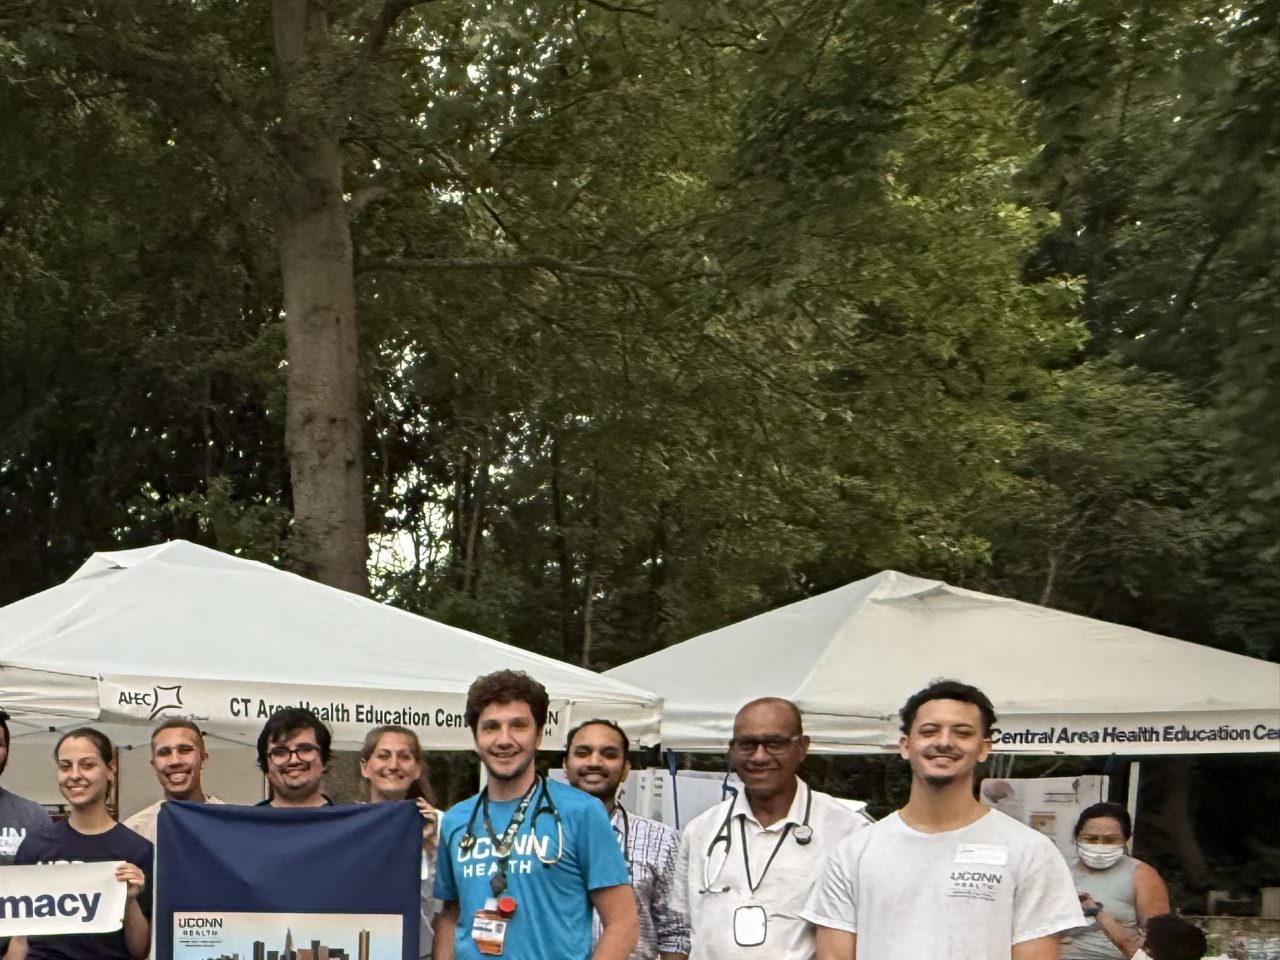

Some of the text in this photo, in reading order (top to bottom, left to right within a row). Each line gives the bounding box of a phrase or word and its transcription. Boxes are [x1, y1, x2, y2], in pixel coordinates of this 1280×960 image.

[229, 697, 251, 717] CT
[355, 704, 430, 726] Education
[991, 728, 1053, 744] Central
[1056, 727, 1098, 743] Area
[1103, 727, 1160, 743] Health
[1163, 725, 1251, 742] Education
[463, 860, 532, 878] HEATH
[178, 918, 223, 928] UCONN
